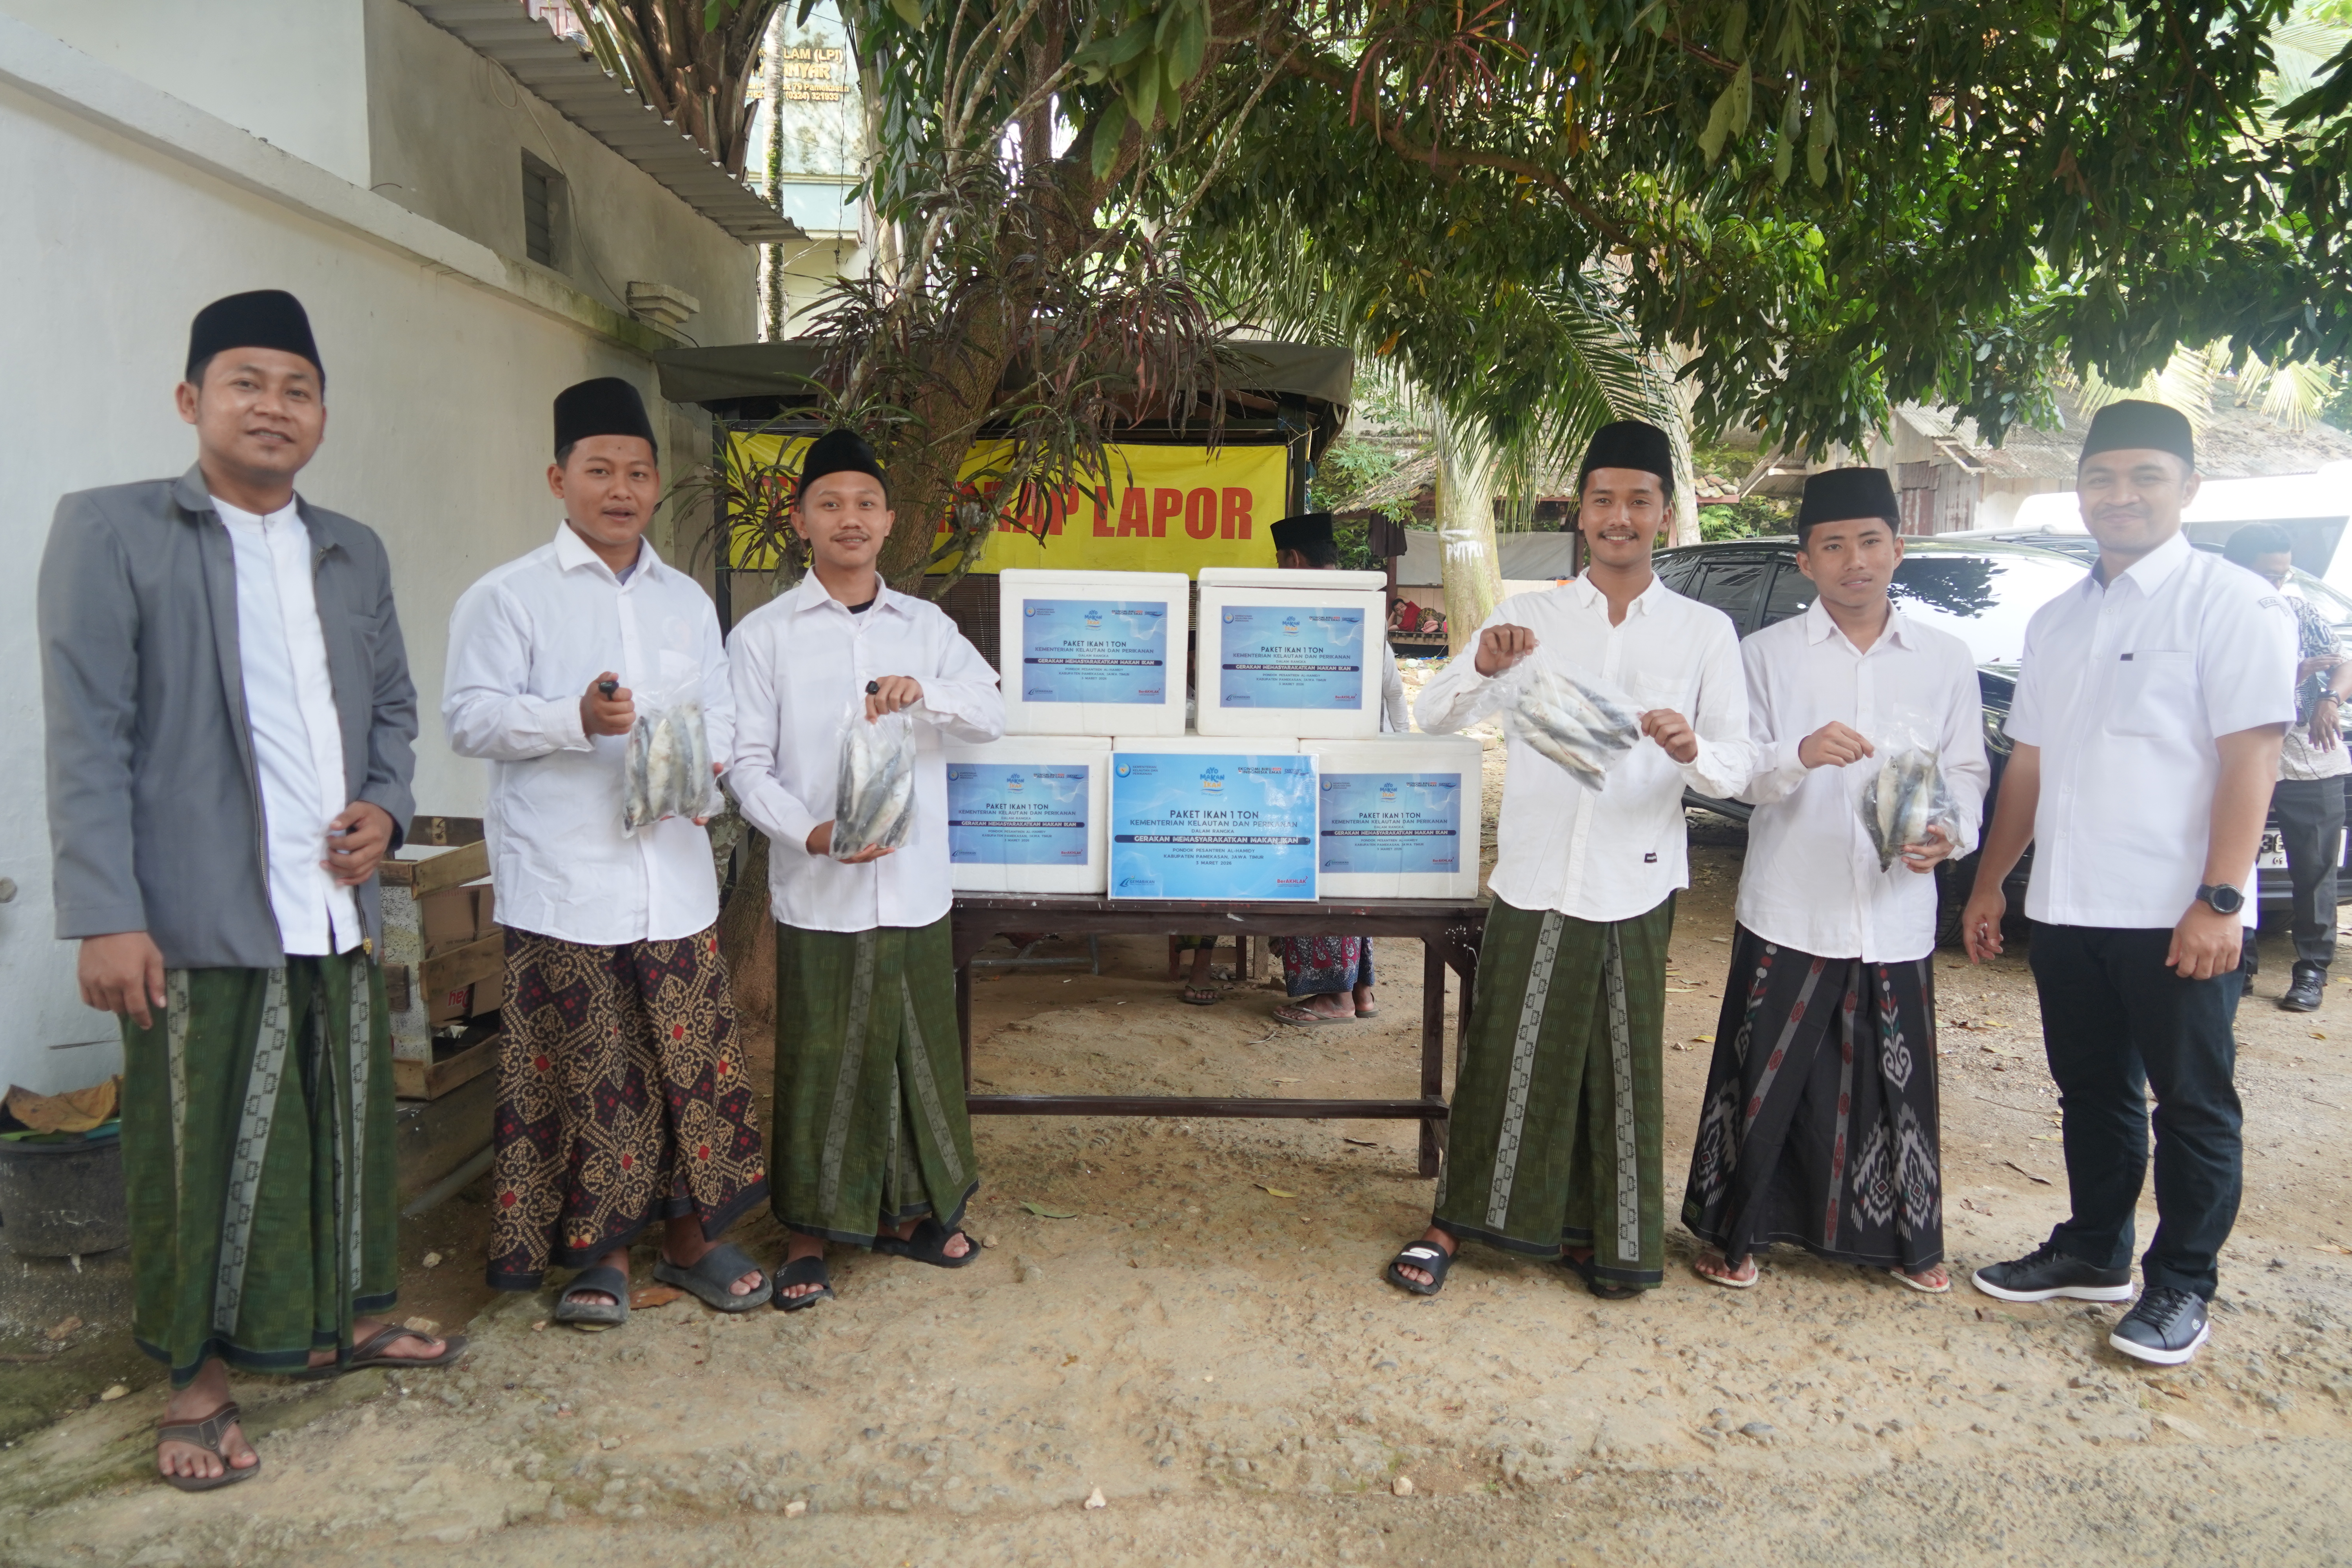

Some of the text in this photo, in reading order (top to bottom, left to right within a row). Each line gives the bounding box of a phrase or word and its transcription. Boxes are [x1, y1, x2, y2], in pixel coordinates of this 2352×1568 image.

[814, 49, 843, 63] (LPI)
[786, 91, 810, 101] (0324)
[811, 92, 839, 101] 321933
[1093, 485, 1253, 539] LAPOR
[1200, 774, 1225, 782] MAKAN
[1170, 810, 1200, 818] PAKET
[1204, 811, 1227, 819] IKAN
[1238, 811, 1258, 819] TON
